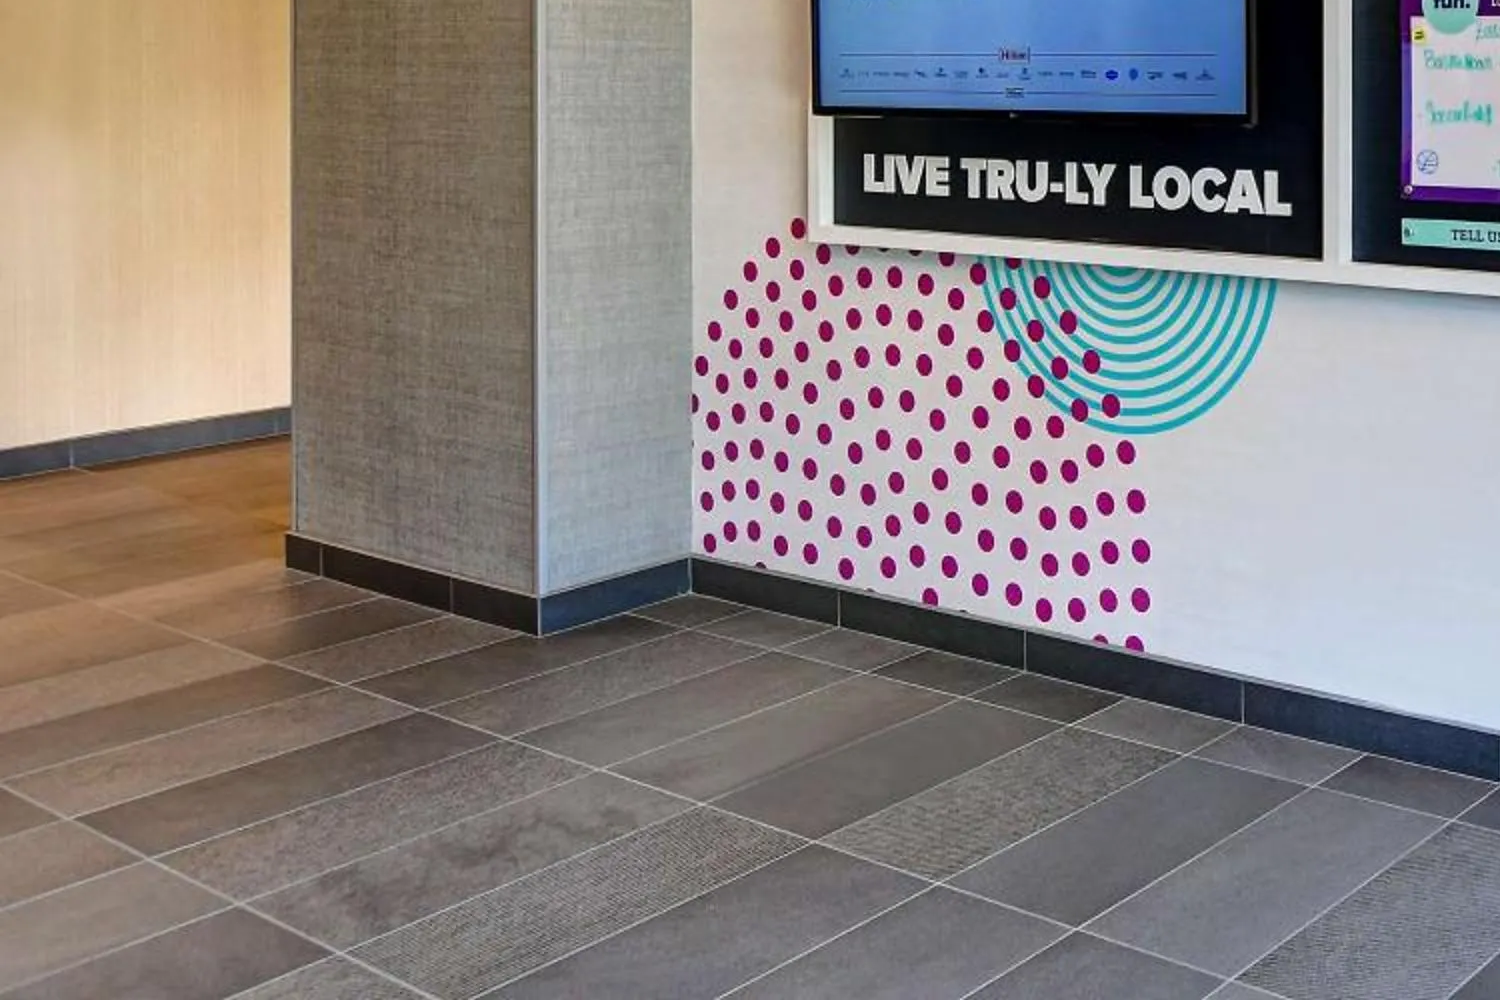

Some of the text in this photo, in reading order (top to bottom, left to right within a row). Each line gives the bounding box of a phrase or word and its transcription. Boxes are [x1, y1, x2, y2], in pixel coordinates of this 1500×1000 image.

[863, 153, 1293, 216] LIVE TRU-LY LOCAL
[1452, 229, 1484, 243] TELL
